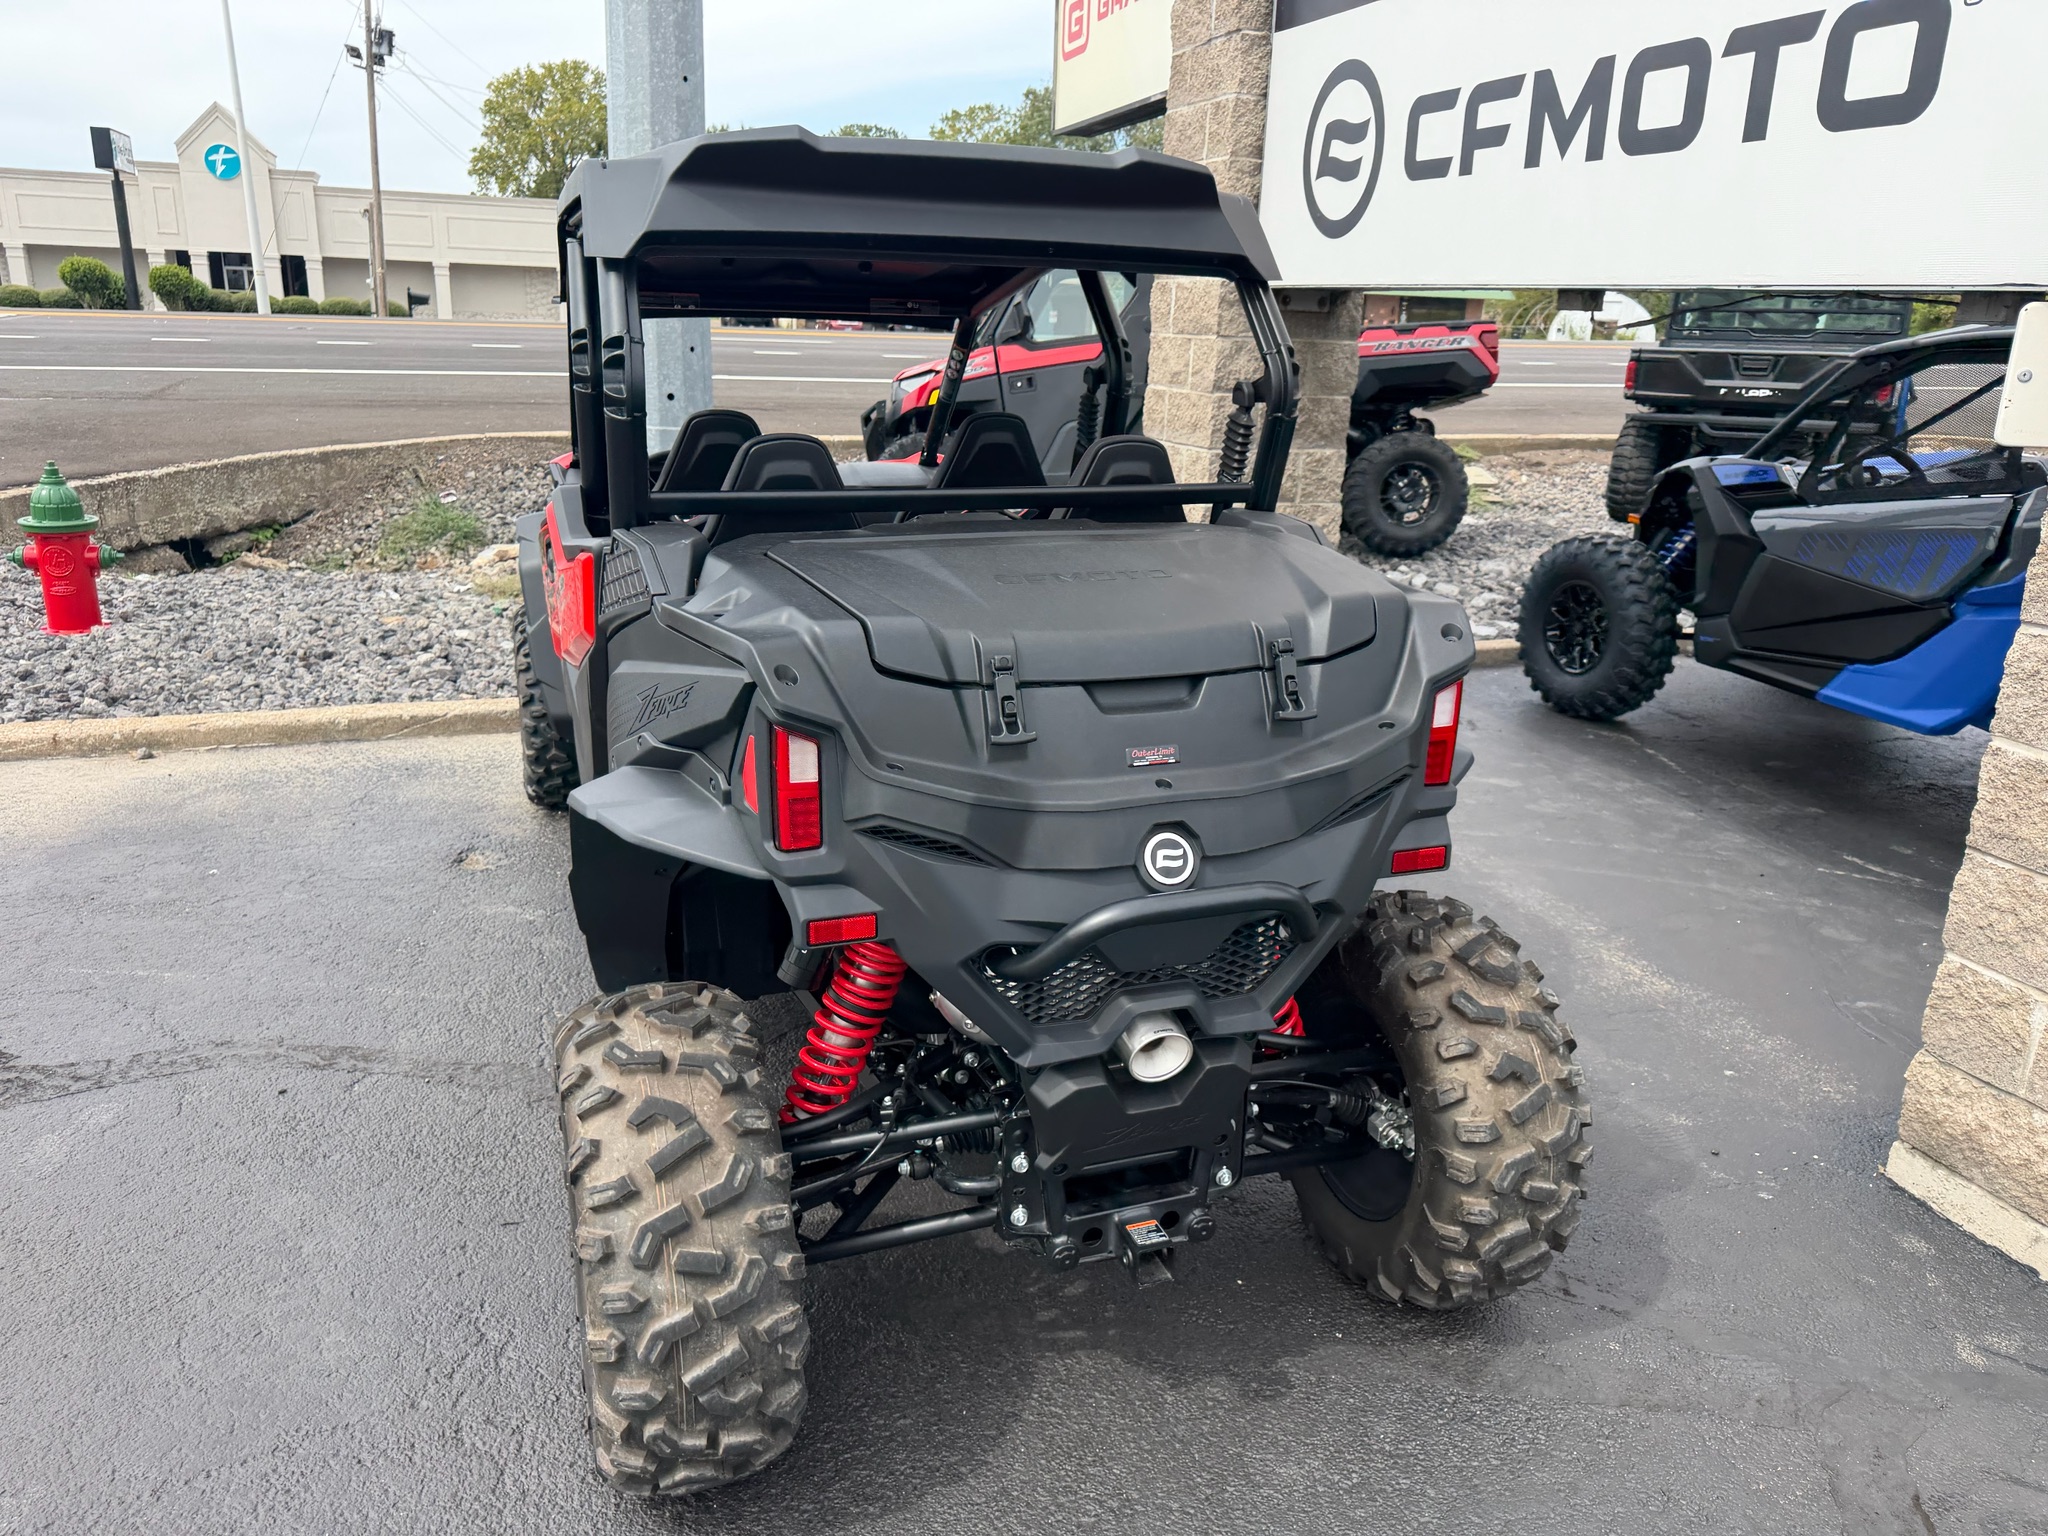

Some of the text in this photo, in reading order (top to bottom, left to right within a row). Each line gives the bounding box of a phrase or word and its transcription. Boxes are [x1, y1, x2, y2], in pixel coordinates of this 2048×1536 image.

[1403, 0, 1952, 182] CFMOTO
[1373, 336, 1467, 352] RANGER
[993, 569, 1173, 586] CFMOTO
